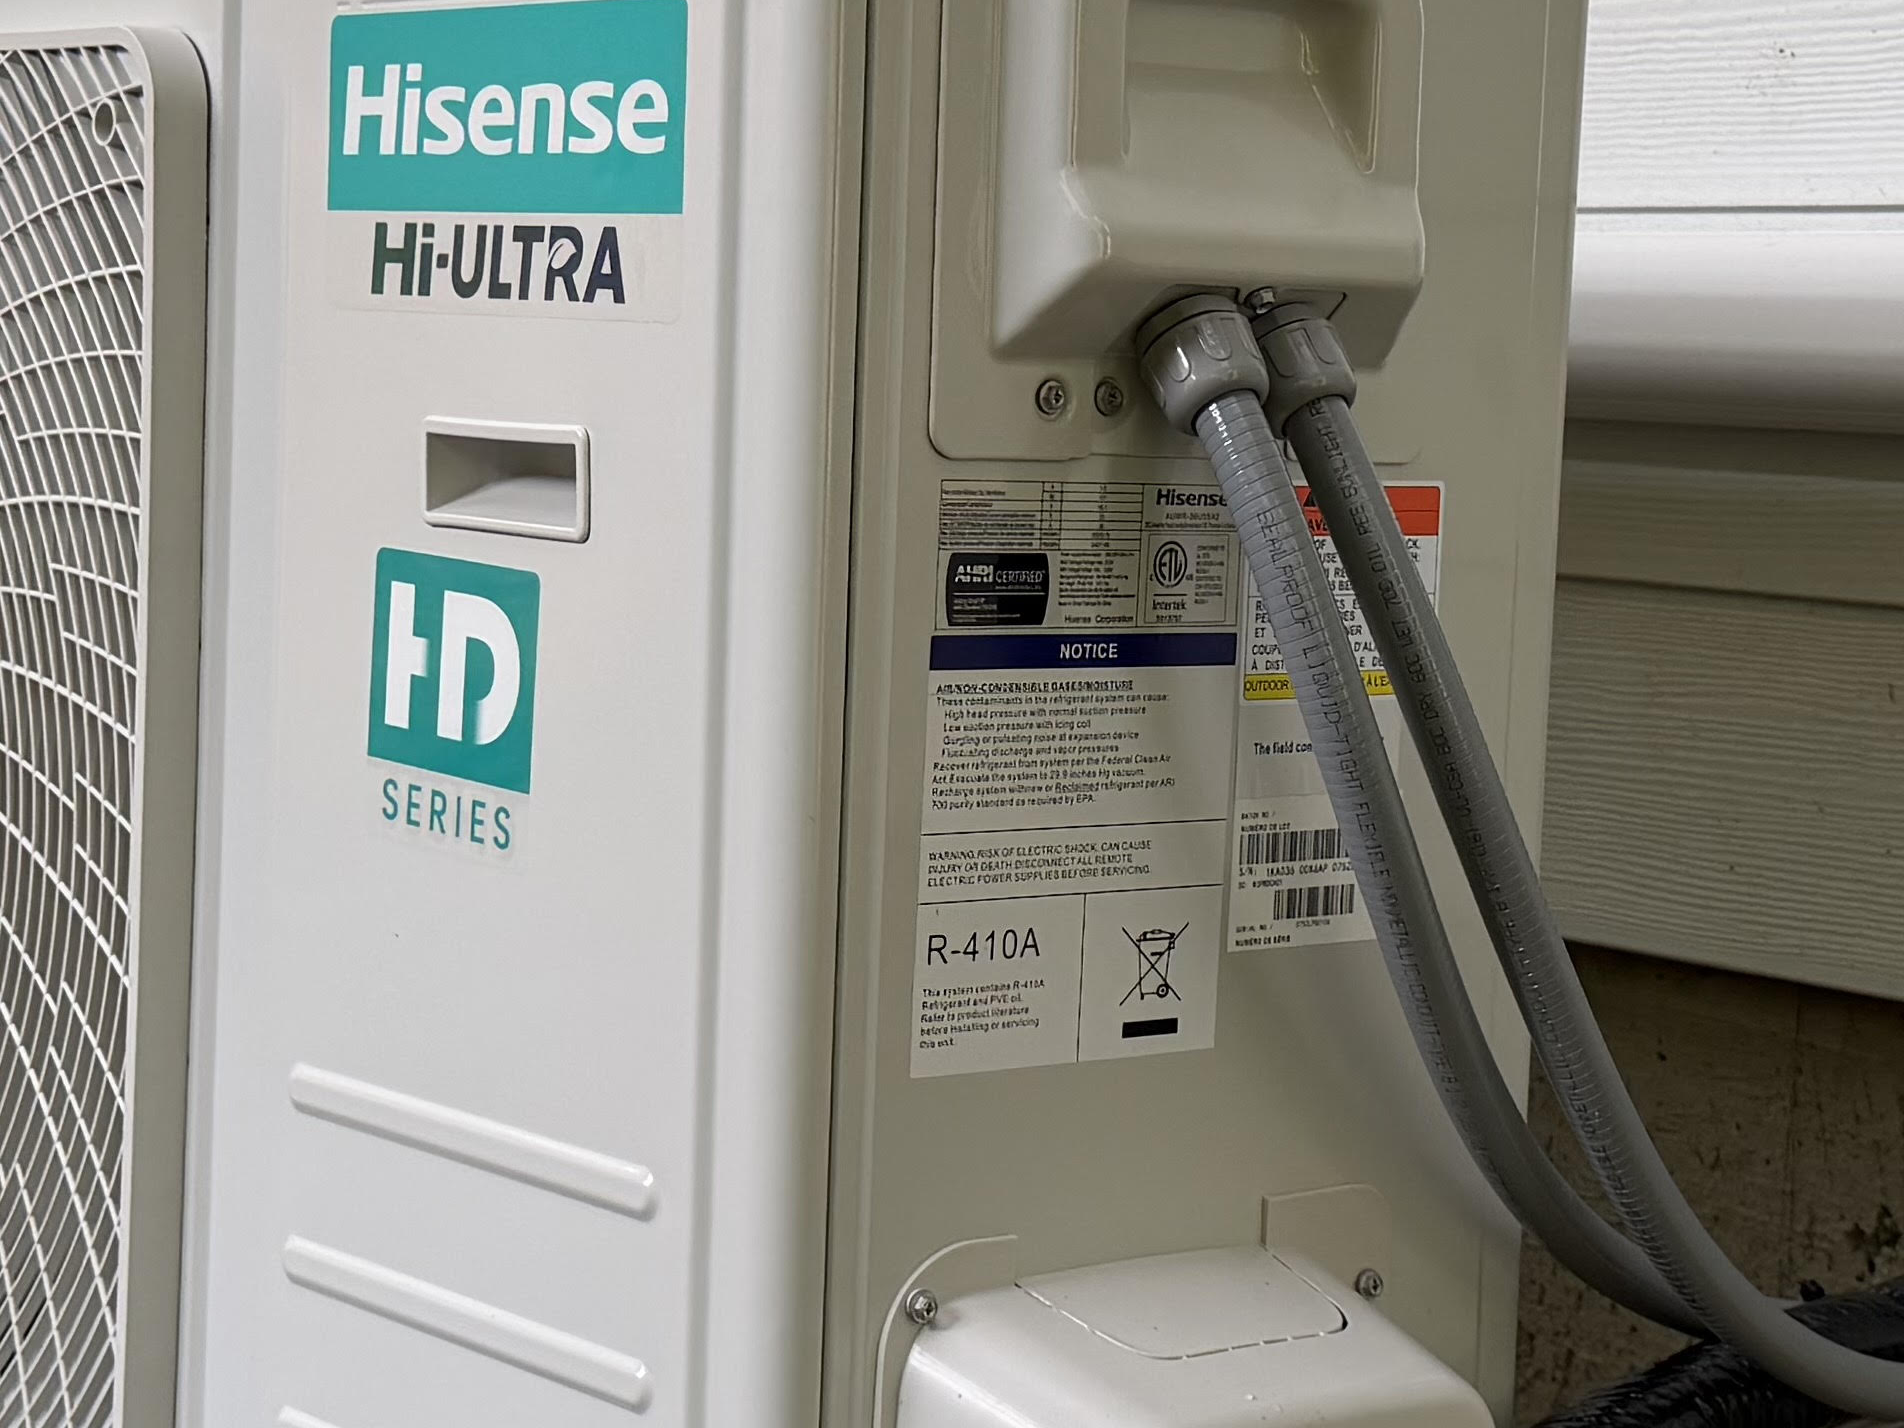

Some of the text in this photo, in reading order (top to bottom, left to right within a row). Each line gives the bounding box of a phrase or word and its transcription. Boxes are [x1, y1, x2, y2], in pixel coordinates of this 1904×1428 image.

[341, 64, 669, 156] Hisense
[371, 222, 627, 306] Hi-ULTRA
[1367, 543, 1387, 573] OIL
[1059, 643, 1119, 660] NOTICE
[384, 579, 521, 746] HD
[1245, 679, 1289, 692] OUTDOOR
[1127, 693, 1141, 702] can
[1111, 706, 1146, 716] pressure
[1253, 741, 1271, 755] The
[381, 778, 513, 852] SERIES
[1001, 846, 1015, 858] OF
[1016, 843, 1062, 857] ELECTRIC
[1100, 841, 1120, 852] CAN
[1121, 839, 1152, 851] CAUSE
[1015, 856, 1076, 870] DISCONNECT
[1077, 855, 1093, 866] ALL
[1095, 853, 1133, 865] REMOTE
[927, 874, 976, 888] ELECTRIC
[977, 872, 1013, 885] POWER
[1014, 869, 1060, 882] SUPPLIES
[1061, 866, 1099, 879] BEFORE
[926, 927, 1041, 966] R-410A
